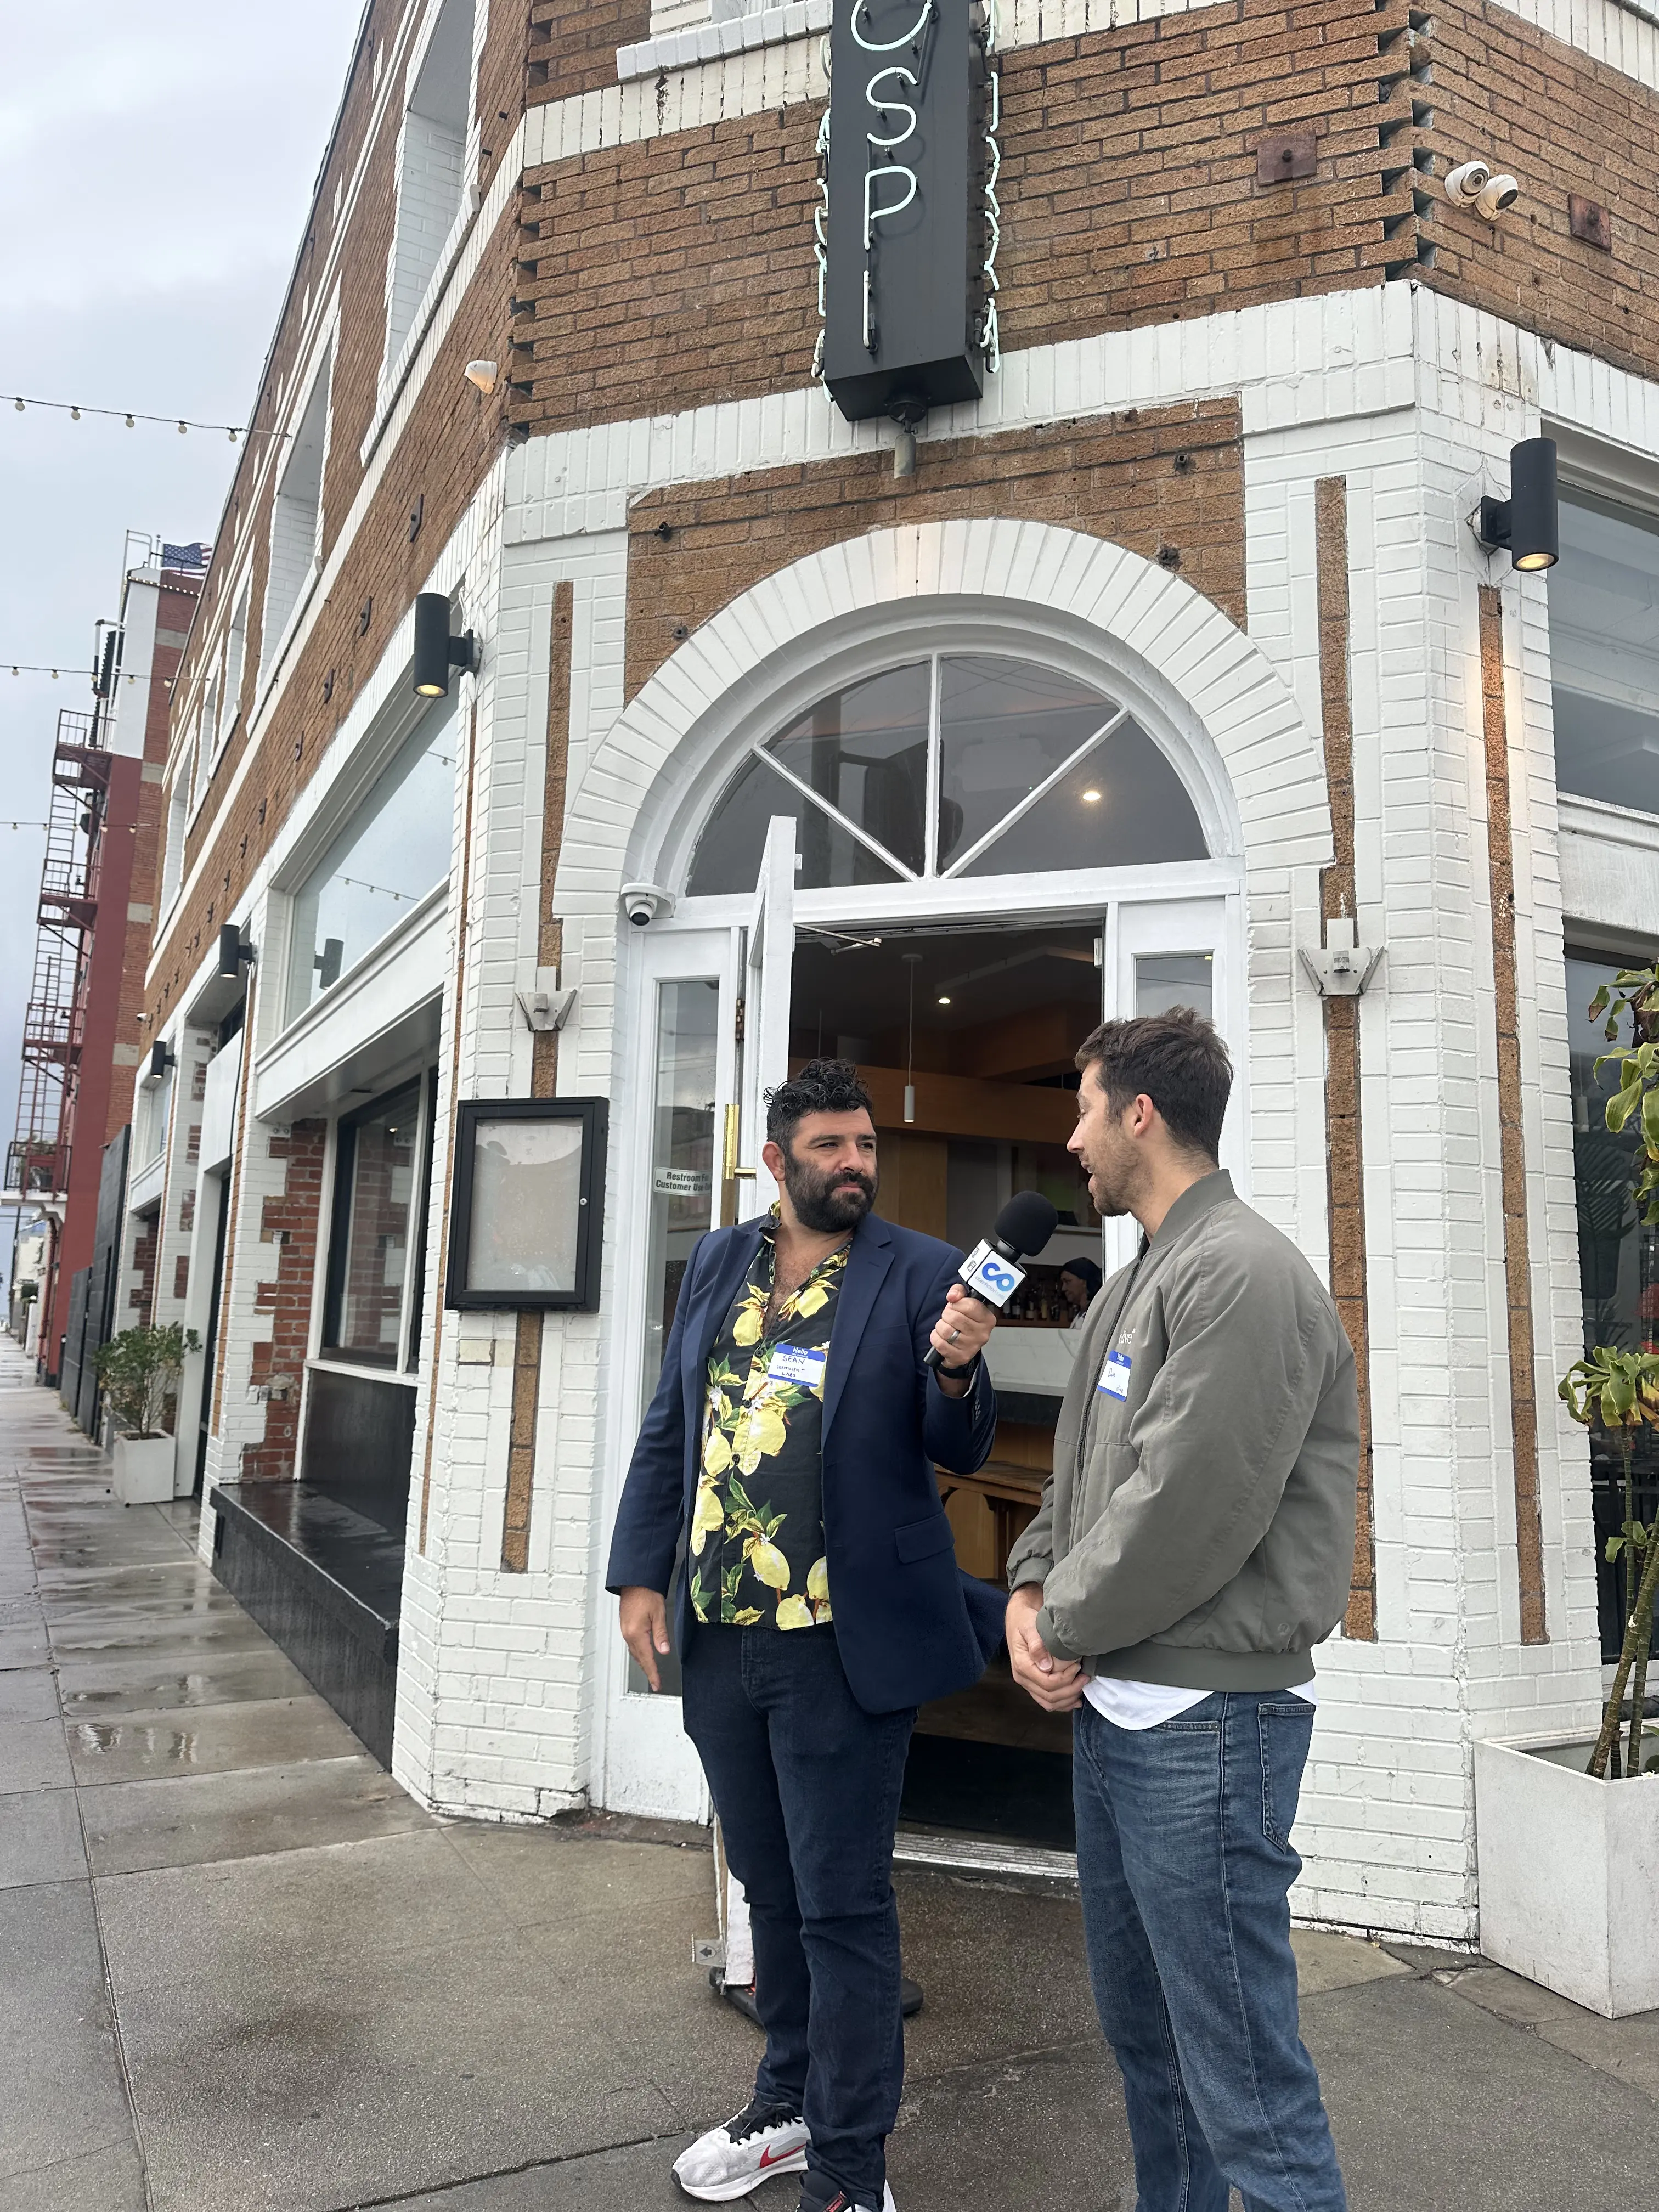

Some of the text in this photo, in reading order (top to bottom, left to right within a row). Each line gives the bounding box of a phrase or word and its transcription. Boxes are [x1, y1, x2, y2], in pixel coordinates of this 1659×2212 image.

[666, 1172, 701, 1182] Restroom
[656, 1180, 692, 1191] Customer
[693, 1183, 703, 1192] Use
[792, 1347, 808, 1355] Hello
[782, 1355, 805, 1365] SEAN
